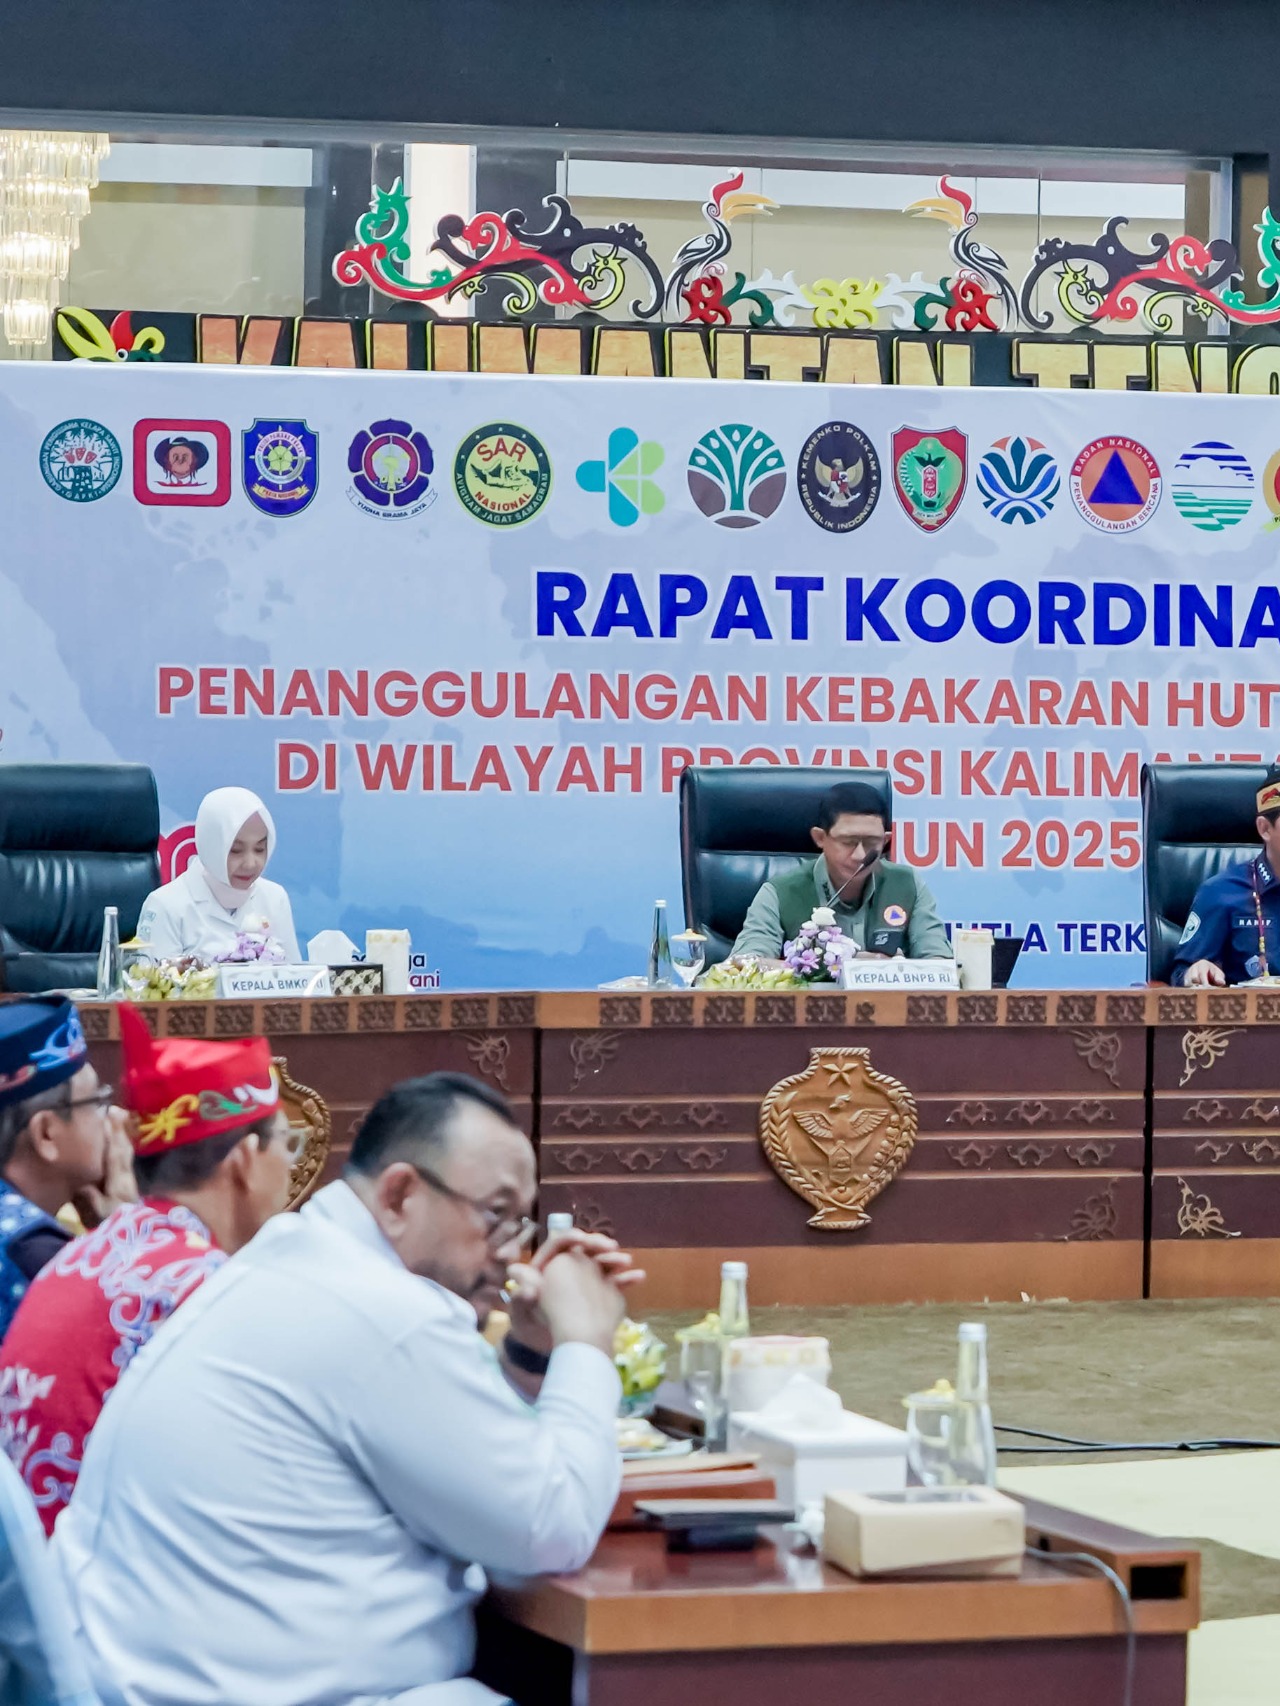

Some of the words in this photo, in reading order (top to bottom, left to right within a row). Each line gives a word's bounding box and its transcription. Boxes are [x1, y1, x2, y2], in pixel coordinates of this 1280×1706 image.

[476, 437, 527, 462] SAR
[801, 425, 841, 469] KEMENKO
[845, 427, 877, 471] POLKAM
[1074, 441, 1104, 472] BADAN
[1109, 438, 1157, 474] NASIONAL
[411, 502, 428, 515] JAYA
[474, 491, 532, 512] NASIONAL
[481, 511, 513, 523] JAGAT
[801, 484, 834, 528] REPUBLIK
[837, 486, 878, 530] INDONESIA
[1073, 481, 1138, 530] PENANGGULANGAN
[1138, 482, 1159, 522] BENCANA
[535, 570, 824, 641] RAPAT
[159, 668, 767, 721] PENANGGULANGAN
[786, 677, 1149, 726] KEBAKARAN
[278, 744, 337, 791] DI
[357, 745, 642, 793] WILAYAH
[1001, 820, 1141, 868] 2025
[231, 979, 275, 992] KEPALA
[854, 972, 900, 984] KEPALA
[904, 972, 935, 984] BNPB
[938, 972, 951, 984] RI
